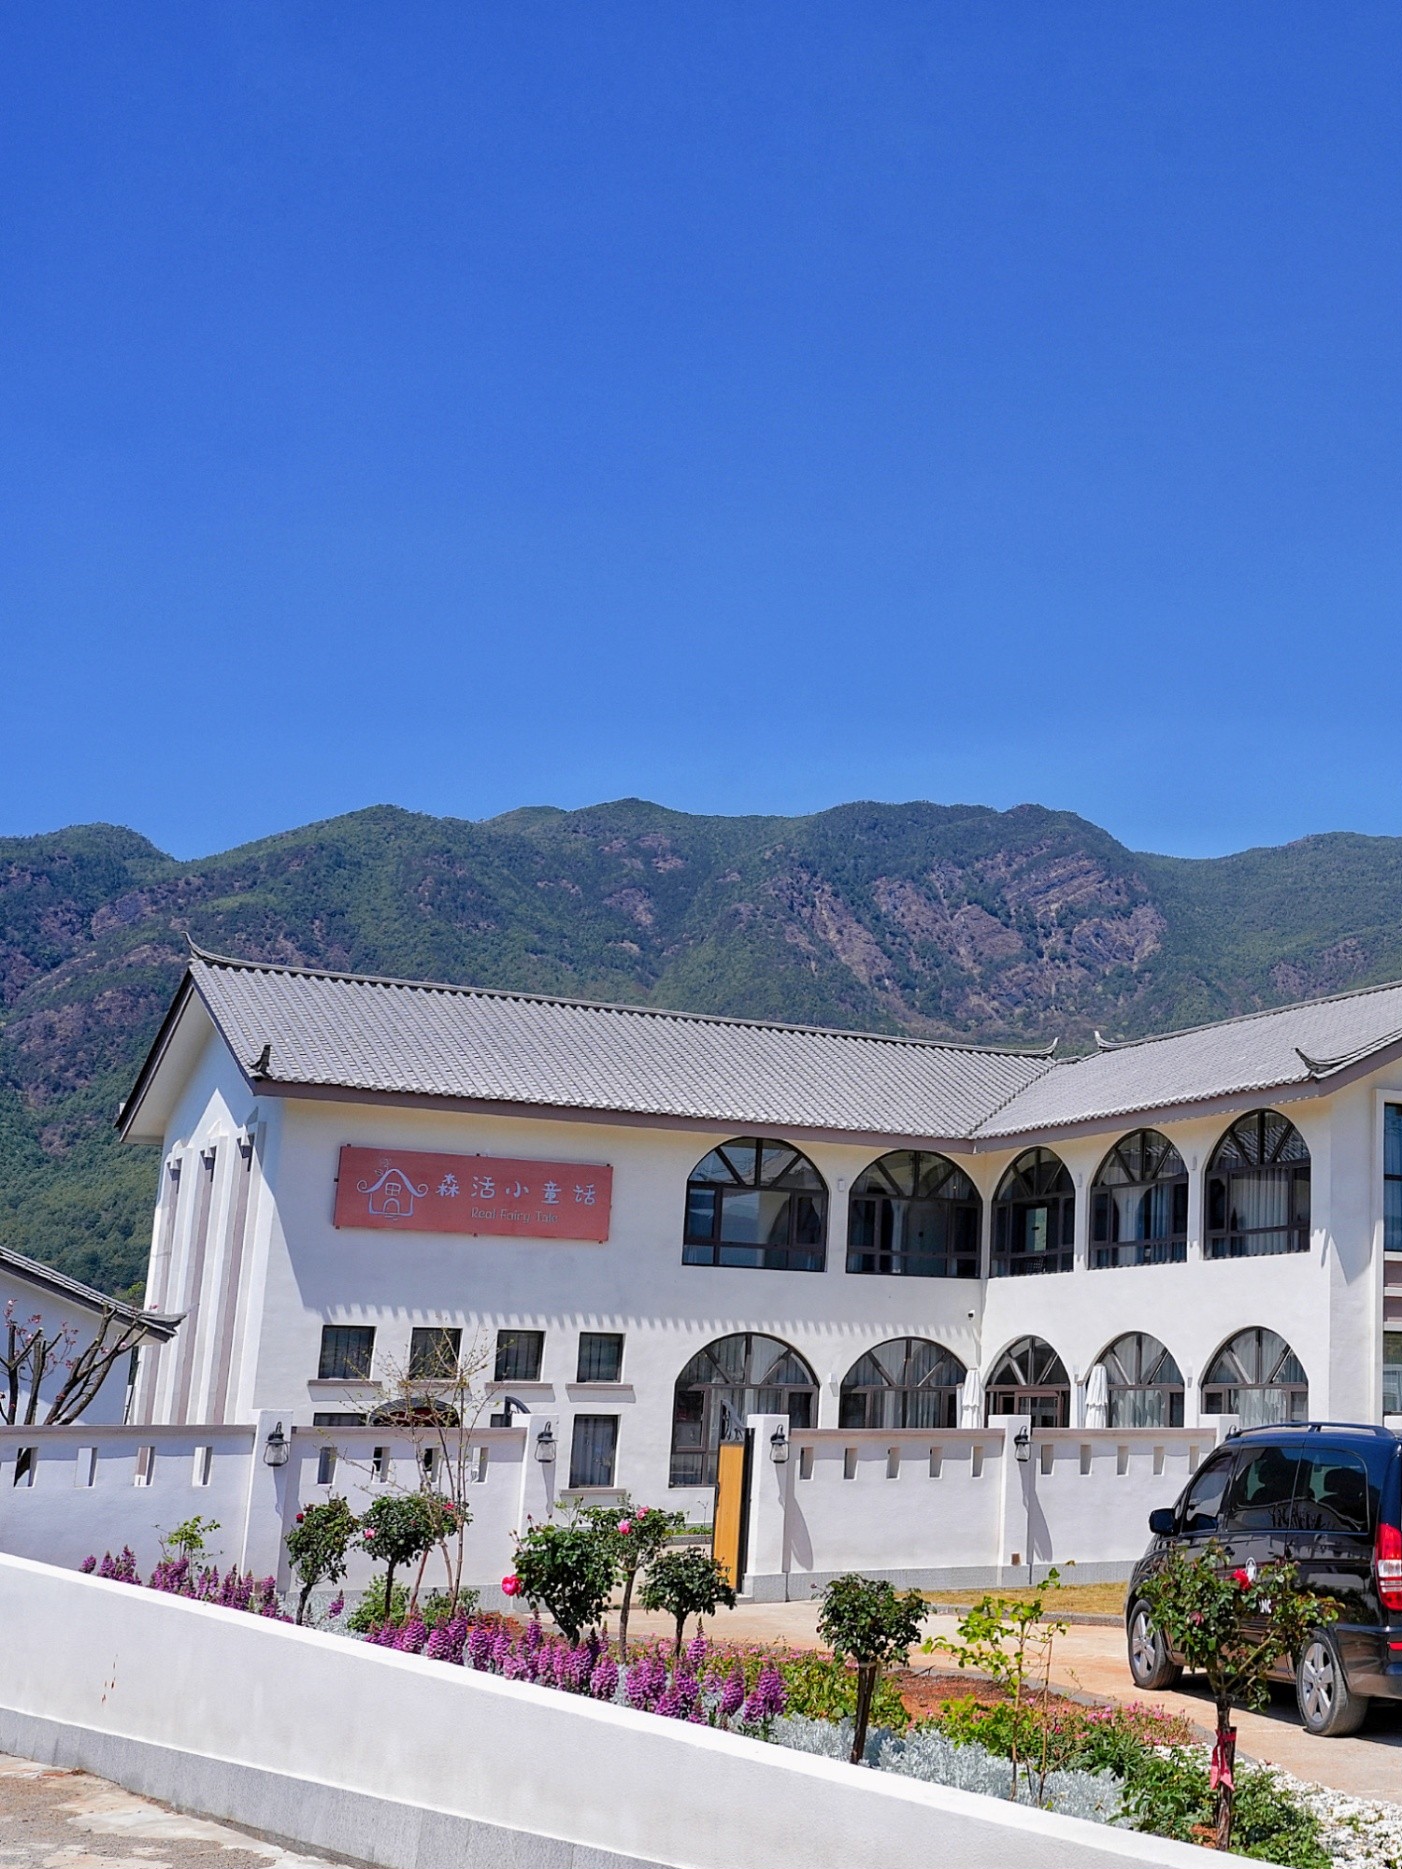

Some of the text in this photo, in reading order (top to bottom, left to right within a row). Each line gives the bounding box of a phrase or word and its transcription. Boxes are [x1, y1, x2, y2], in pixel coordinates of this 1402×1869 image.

[435, 1172, 597, 1206] 森活小童话
[471, 1207, 558, 1224] Real Fairy Tale
